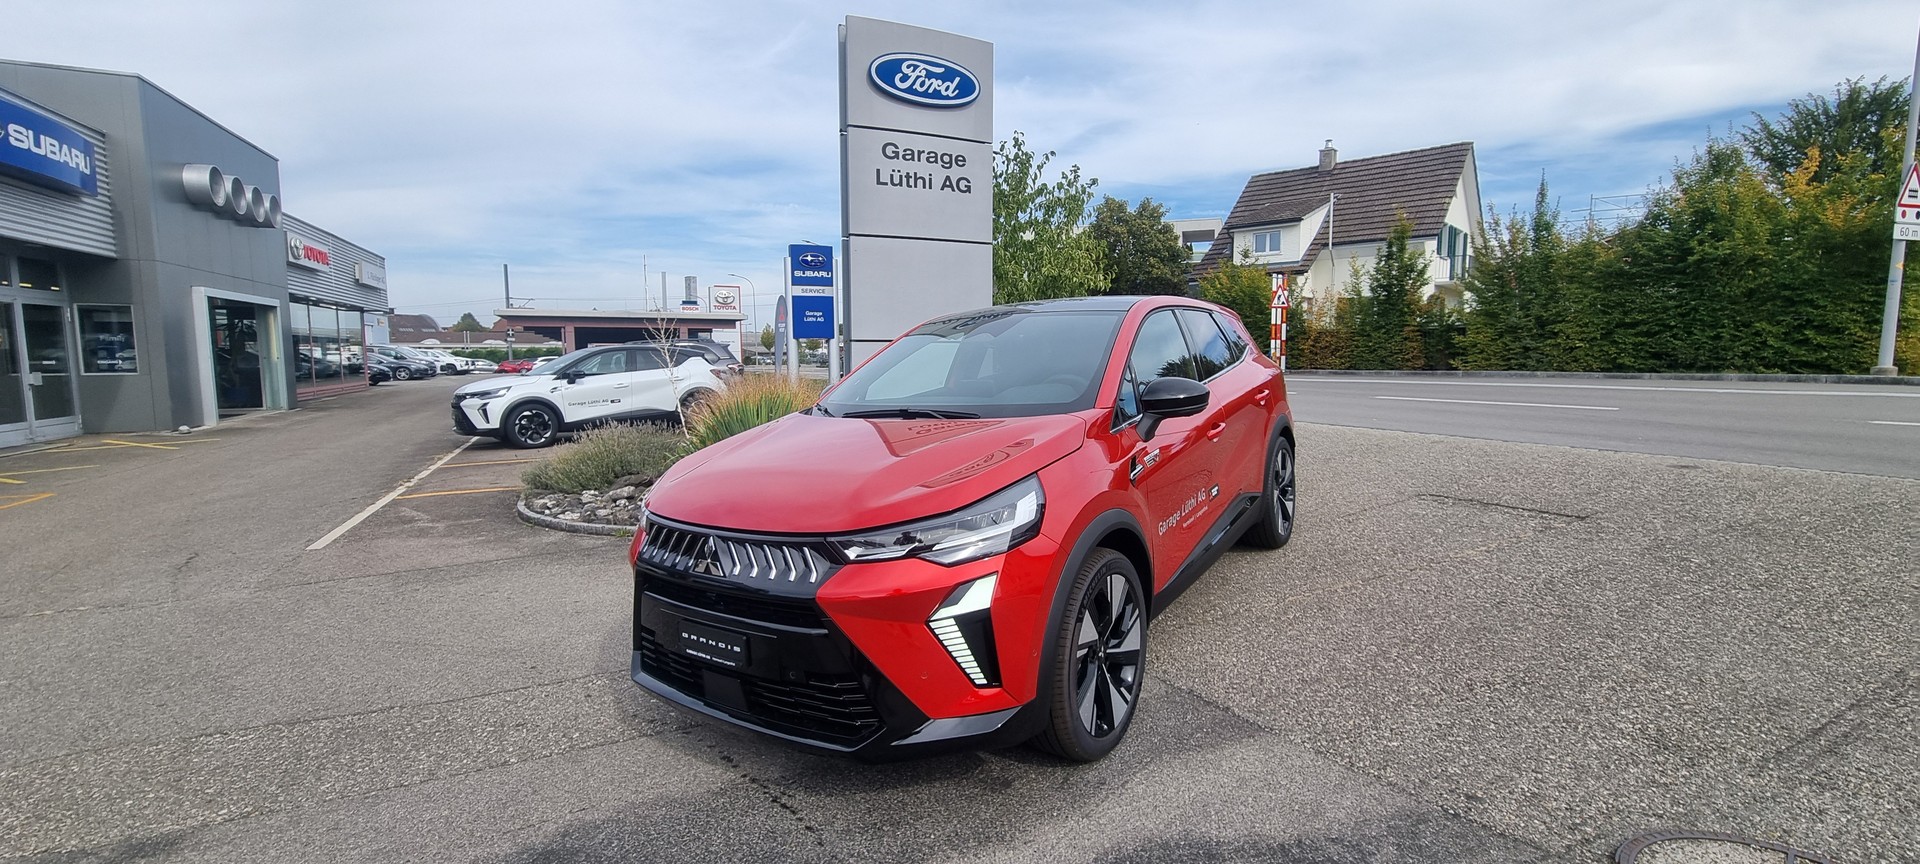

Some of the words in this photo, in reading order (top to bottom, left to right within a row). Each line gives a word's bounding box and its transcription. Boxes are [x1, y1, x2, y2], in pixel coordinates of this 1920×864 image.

[894, 60, 961, 97] Ford
[7, 123, 91, 175] SUBARU
[881, 141, 967, 170] Garage
[875, 168, 933, 190] Lüthi
[940, 175, 972, 195] AG
[1899, 226, 1910, 237] 60
[304, 245, 329, 266] TOYOTA
[793, 270, 832, 278] SUBARU
[1158, 510, 1181, 536] Garage
[1181, 494, 1197, 516] Lüthi
[1197, 487, 1206, 504] AG
[681, 632, 741, 652] GRANDIS
